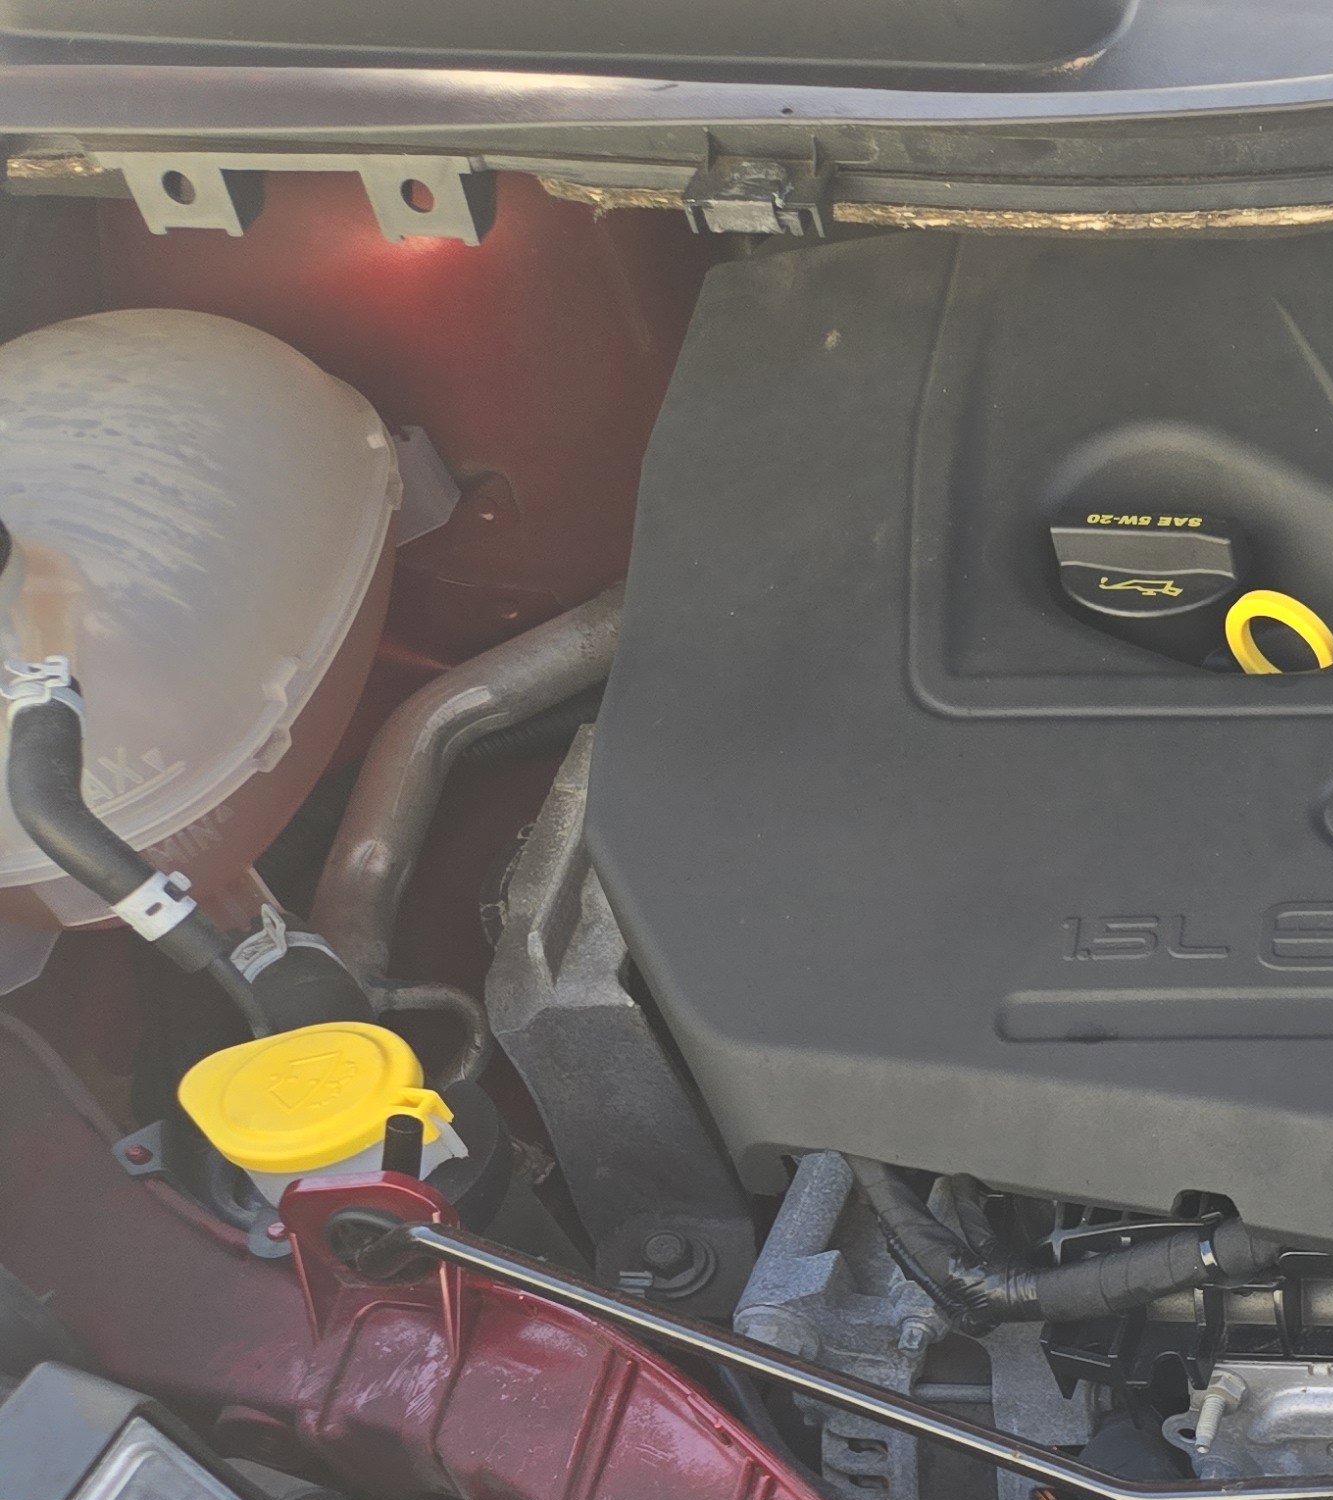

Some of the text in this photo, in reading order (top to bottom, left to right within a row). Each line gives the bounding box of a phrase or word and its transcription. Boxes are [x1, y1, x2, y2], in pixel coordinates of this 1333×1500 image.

[1087, 513, 1203, 528] SAE 5W-20
[1060, 913, 1231, 962] 1.5L
